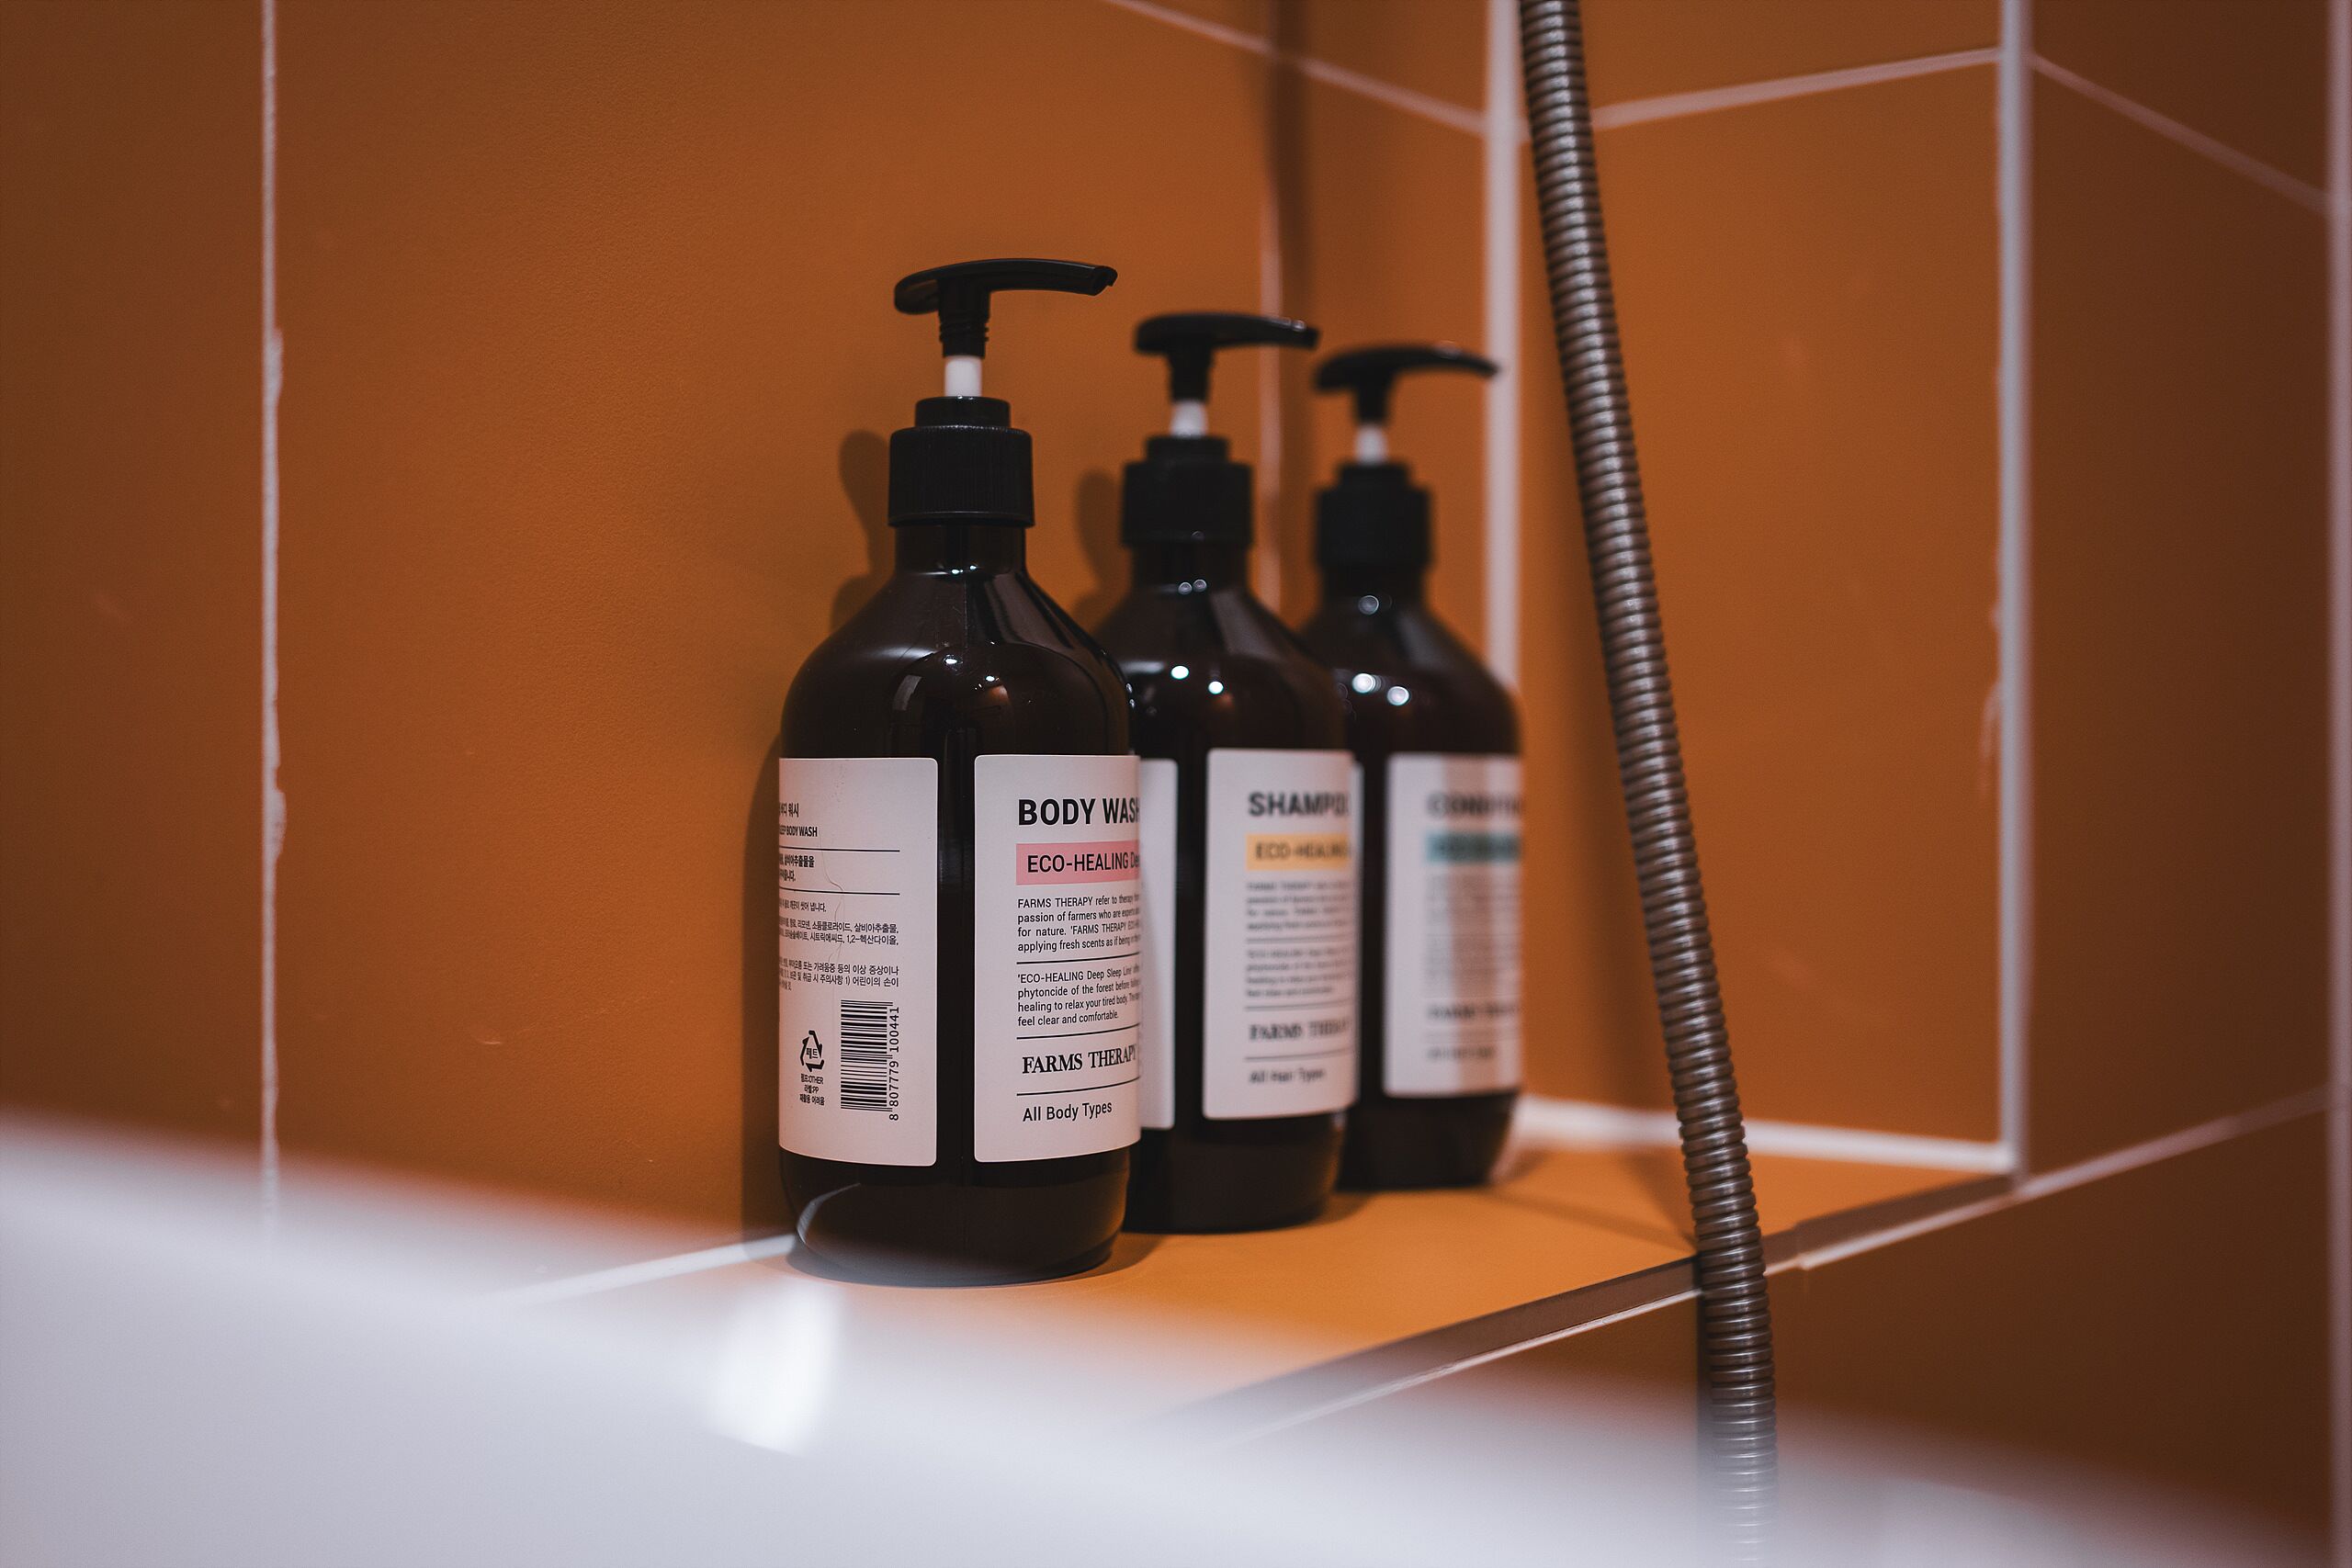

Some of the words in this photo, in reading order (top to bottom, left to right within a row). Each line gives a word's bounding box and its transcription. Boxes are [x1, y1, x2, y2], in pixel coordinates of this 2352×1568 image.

[1018, 798, 1096, 826] BODY
[1248, 791, 1349, 817] SHAMPO
[786, 826, 798, 836] BODY
[799, 827, 818, 837] WASH
[1027, 852, 1128, 873] ECO-HEALING
[1017, 898, 1052, 908] FARMS
[1056, 897, 1093, 908] THERAPY
[1095, 896, 1110, 906] refer
[1112, 897, 1118, 905] to
[1017, 912, 1055, 925] passion
[1057, 911, 1067, 921] of
[1068, 910, 1097, 921] farmers
[1098, 909, 1112, 919] who
[1113, 910, 1121, 919] are
[1017, 927, 1031, 937] for
[1035, 928, 1067, 937] nature.
[1070, 924, 1099, 935] 'FARMS
[1102, 922, 1126, 932] THERAPY
[1017, 940, 1057, 953] applying
[1059, 939, 1080, 950] fresh
[1081, 938, 1105, 949] scents
[1114, 935, 1118, 945] if
[837, 964, 851, 974] 등의
[853, 964, 866, 975] 이상
[869, 964, 899, 976] 증상이나
[1018, 971, 1084, 984] 'ECO-HEALING
[1087, 970, 1104, 981] Deep
[1106, 968, 1122, 978] Sleep
[813, 974, 819, 983] 시
[820, 974, 843, 986] 주의사항
[853, 976, 881, 987] 어린이의
[883, 977, 899, 987] 손이
[1017, 987, 1069, 999] phytoncide
[1070, 985, 1080, 995] of
[1082, 984, 1094, 994] the
[1096, 983, 1114, 993] forest
[1017, 1001, 1052, 1013] healing
[1054, 1001, 1063, 1010] to
[1065, 999, 1084, 1010] relax
[1085, 999, 1102, 1010] your
[1102, 996, 1115, 1007] tired
[1017, 1016, 1035, 1026] feel
[1037, 1015, 1060, 1026] clear
[1061, 1013, 1078, 1024] and
[888, 1007, 899, 1053] 100441
[1022, 1053, 1082, 1074] FARMS
[1088, 1043, 1136, 1068] THERAPY
[888, 1060, 899, 1108] 807779
[888, 1113, 899, 1122] 8
[1023, 1106, 1041, 1122] All
[1046, 1104, 1079, 1121] Body
[1081, 1101, 1113, 1119] Types
